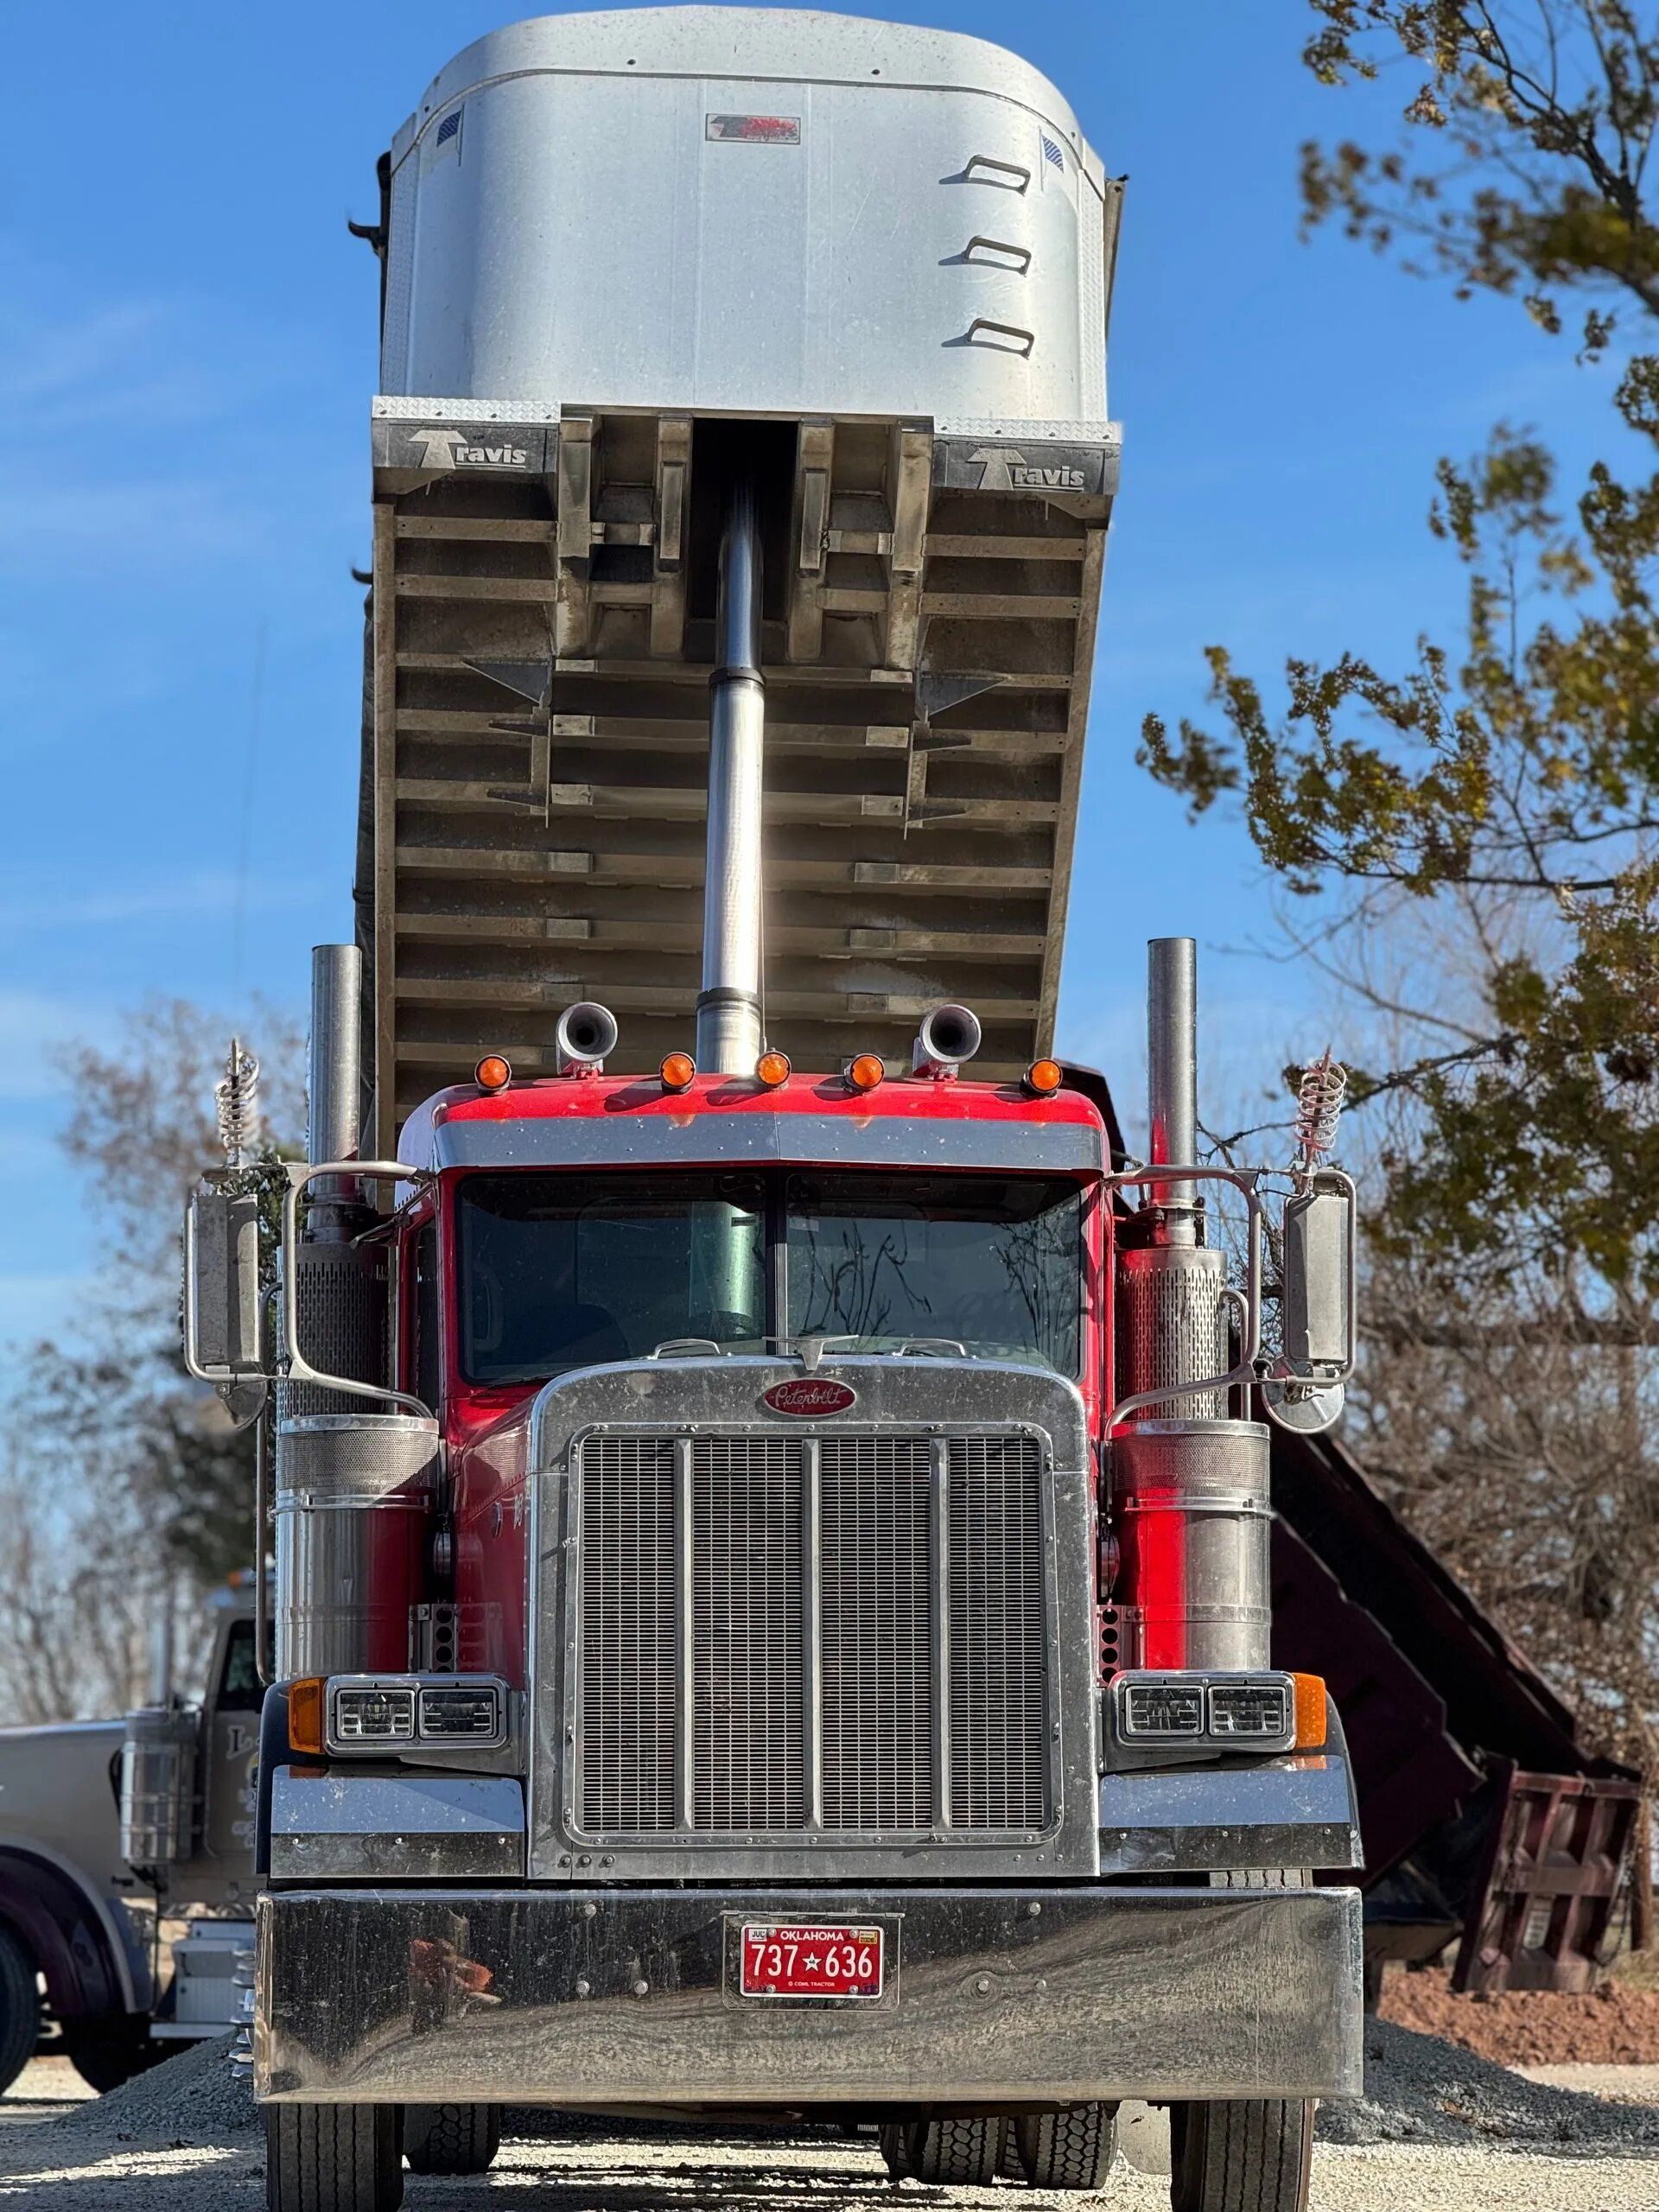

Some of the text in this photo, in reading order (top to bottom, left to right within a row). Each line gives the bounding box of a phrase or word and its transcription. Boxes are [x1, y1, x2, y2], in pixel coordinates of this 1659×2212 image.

[408, 429, 527, 470] Travis
[965, 448, 1084, 491] Travis
[775, 1385, 849, 1408] Peterbilt
[780, 1930, 844, 1942] OKLAHOMA
[751, 1944, 873, 1978] 737 636
